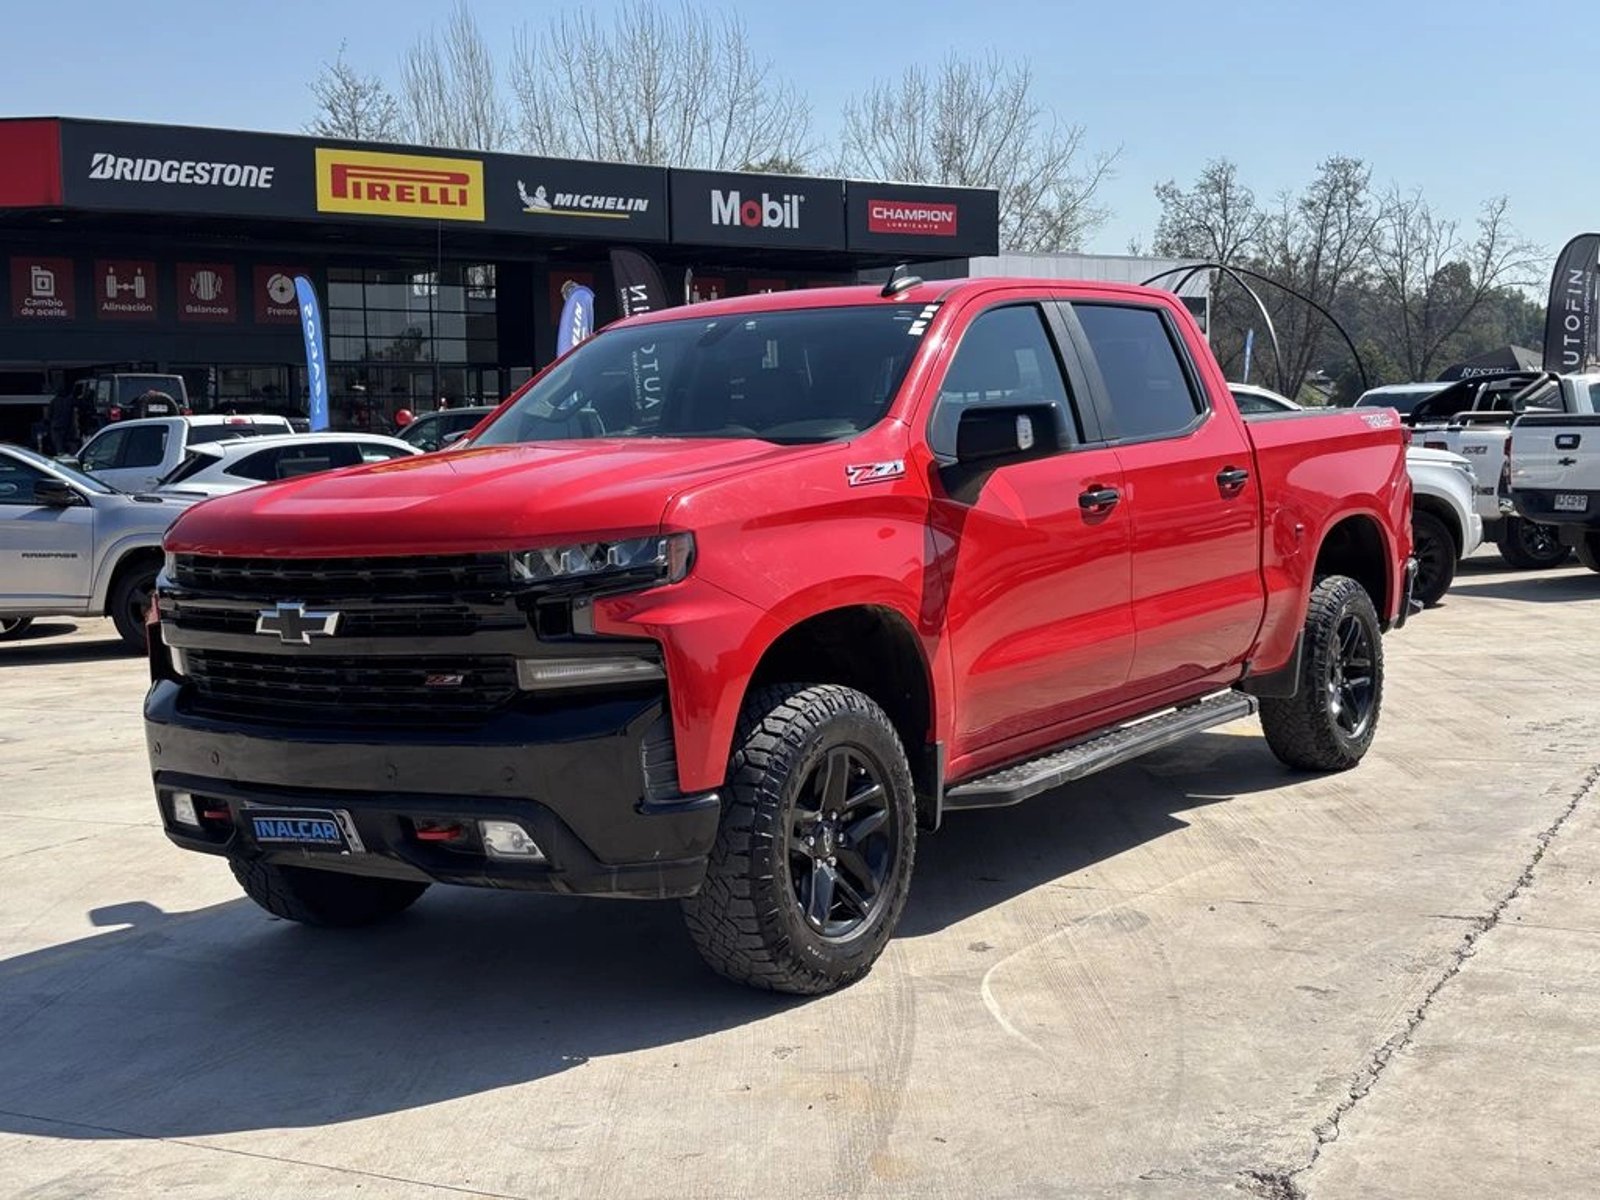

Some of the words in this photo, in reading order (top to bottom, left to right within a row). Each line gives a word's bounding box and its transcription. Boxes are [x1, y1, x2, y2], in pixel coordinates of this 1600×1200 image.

[88, 152, 275, 189] BRIDGESTONE
[330, 163, 471, 207] PIRELLI
[553, 192, 649, 213] MICHELIN
[711, 189, 800, 229] Mobil
[872, 207, 954, 222] CHAMPION
[24, 297, 63, 307] Cambio
[102, 301, 153, 312] Alineación
[185, 304, 229, 314] Balanceo
[21, 307, 35, 316] de
[36, 308, 68, 317] aceite
[267, 306, 298, 316] Frenos
[1562, 269, 1584, 365] UTOFIN
[254, 820, 337, 840] INALCAR
